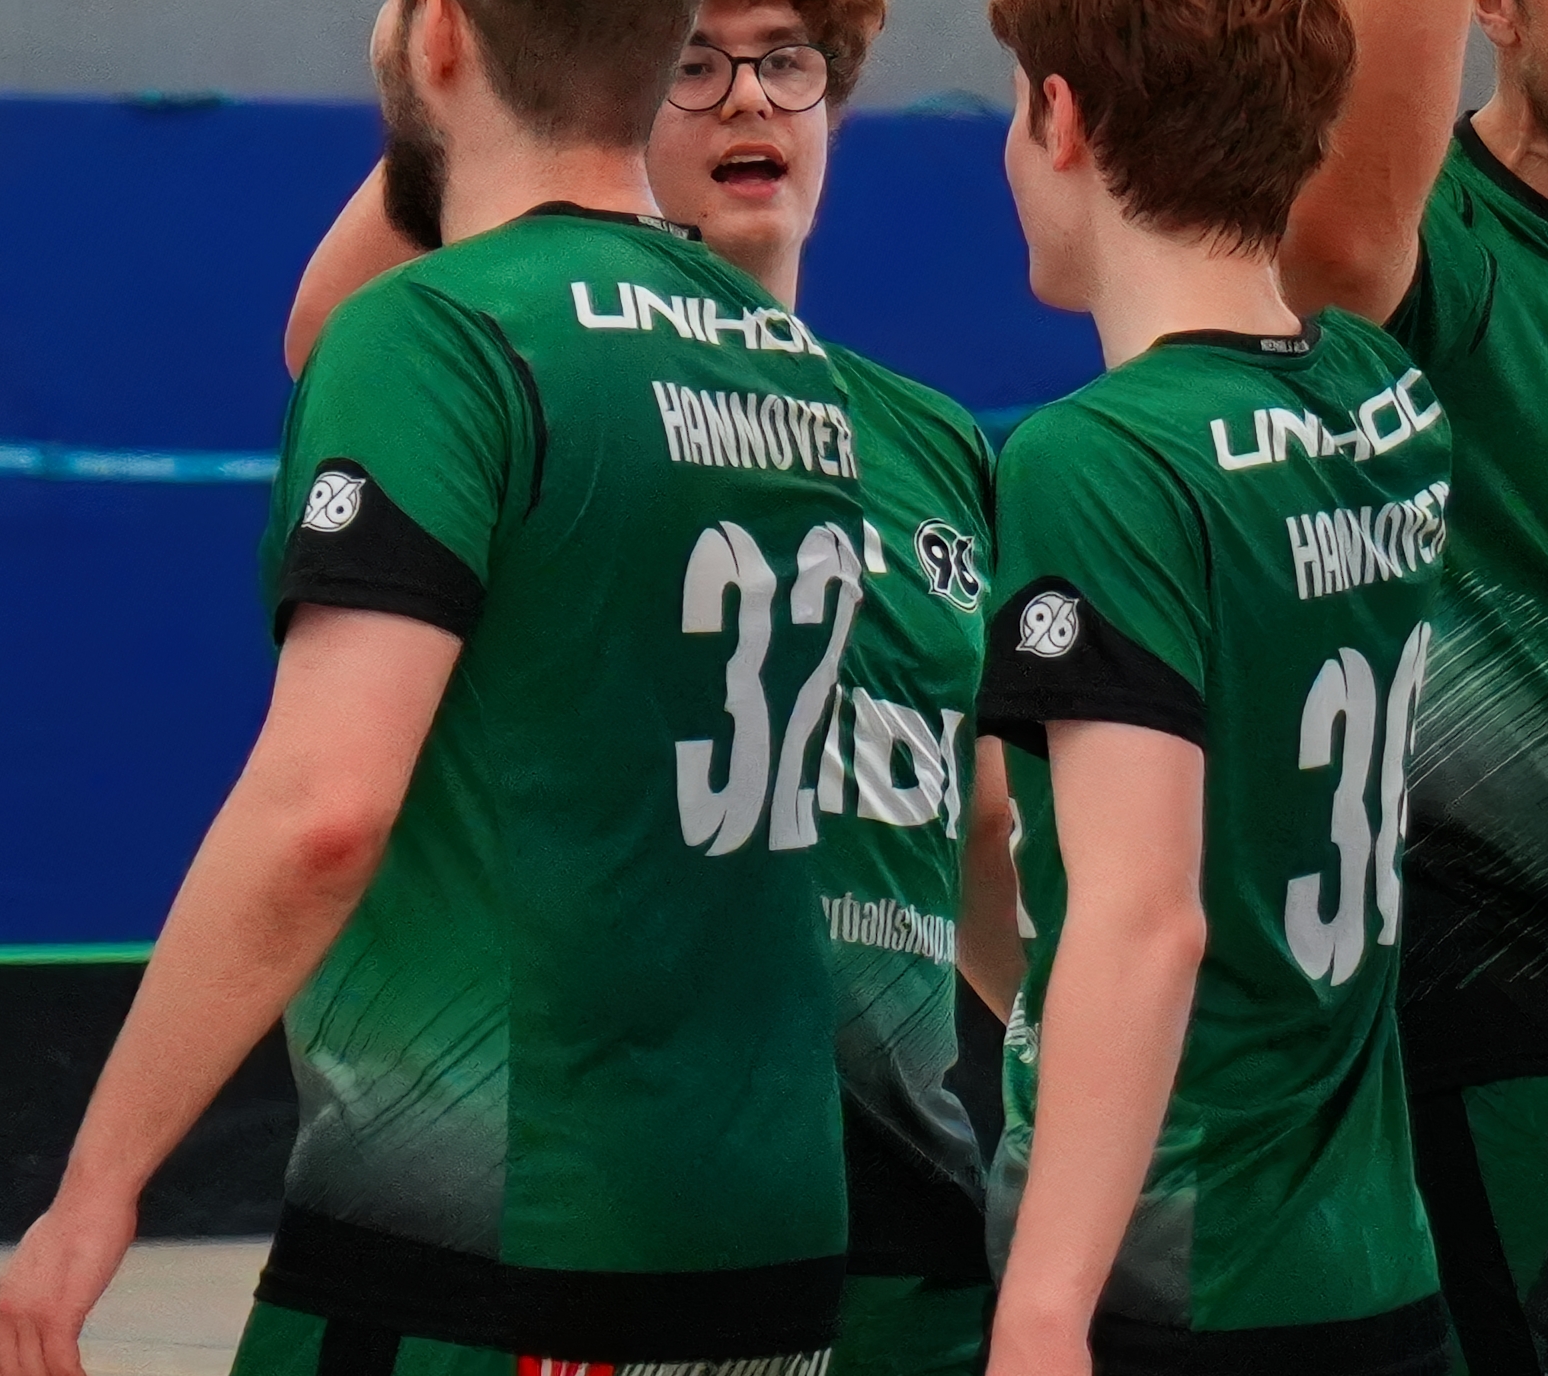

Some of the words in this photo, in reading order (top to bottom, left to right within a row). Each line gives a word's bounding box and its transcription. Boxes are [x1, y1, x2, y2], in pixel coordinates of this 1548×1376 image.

[651, 381, 858, 479] HANNOVER
[1210, 367, 1442, 470] UNHOC
[305, 476, 363, 528] 96
[1286, 481, 1450, 599] HANOVER
[920, 526, 981, 602] 96
[1018, 596, 1077, 652] 96
[676, 520, 863, 856] 32
